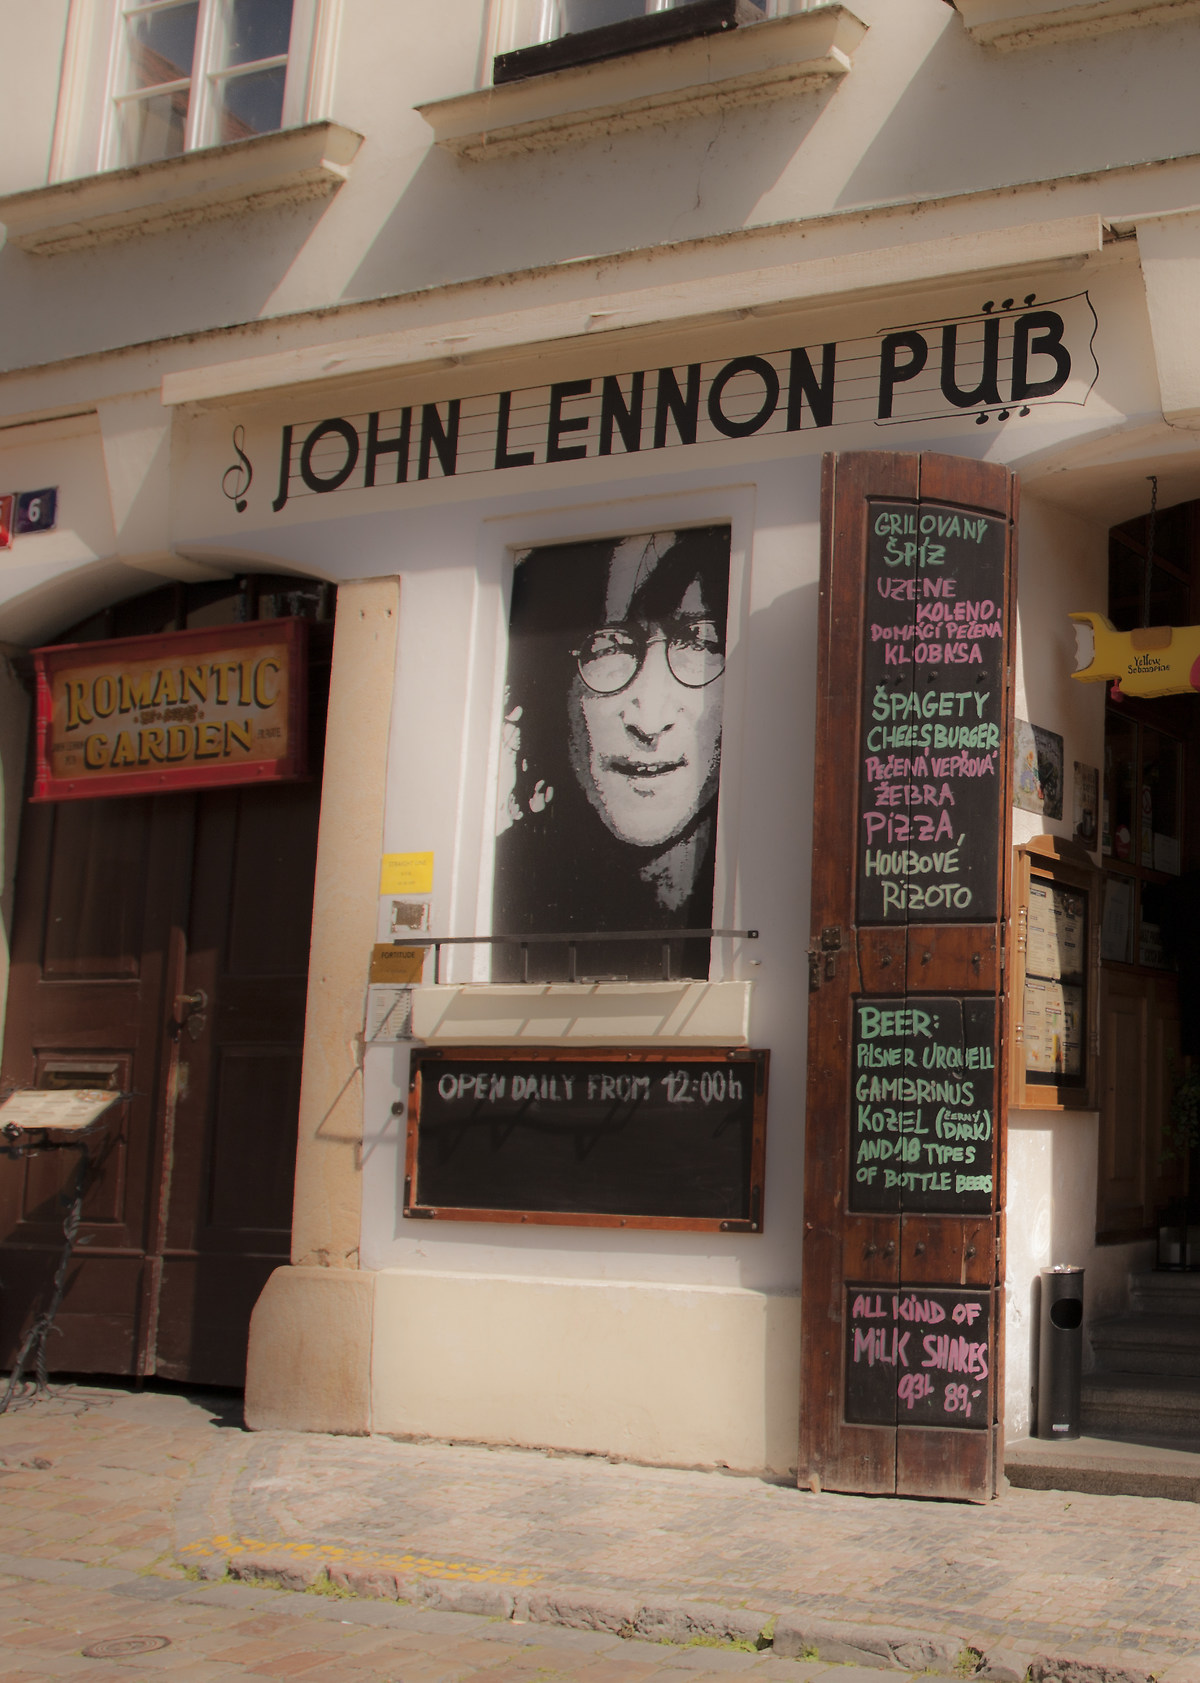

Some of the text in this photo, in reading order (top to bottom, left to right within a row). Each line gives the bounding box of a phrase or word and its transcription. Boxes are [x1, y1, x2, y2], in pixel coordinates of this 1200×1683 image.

[272, 310, 1072, 513] JOHN LENNON PUB
[28, 498, 41, 523] 6
[1134, 653, 1161, 666] Yellow
[64, 656, 282, 733] ROMANTIC
[871, 685, 990, 721] ŠPAGETY
[83, 717, 256, 771] GARDEN
[874, 781, 956, 807] ŽEBRA
[381, 951, 416, 959] FORTITUDE
[858, 1006, 940, 1039] BEER:
[922, 1042, 995, 1070] URQUELL
[438, 1073, 505, 1103] OPEN
[512, 1073, 577, 1102] DAILY
[588, 1073, 650, 1102] FROM
[857, 1104, 929, 1134] KOZEL
[856, 1138, 893, 1164] AND
[923, 1143, 977, 1165] TYPES
[856, 1166, 992, 1194] OF BOTTLE BEERS
[852, 1294, 887, 1319] ALL
[952, 1303, 982, 1326] OF
[921, 1334, 989, 1381] SHAKES
